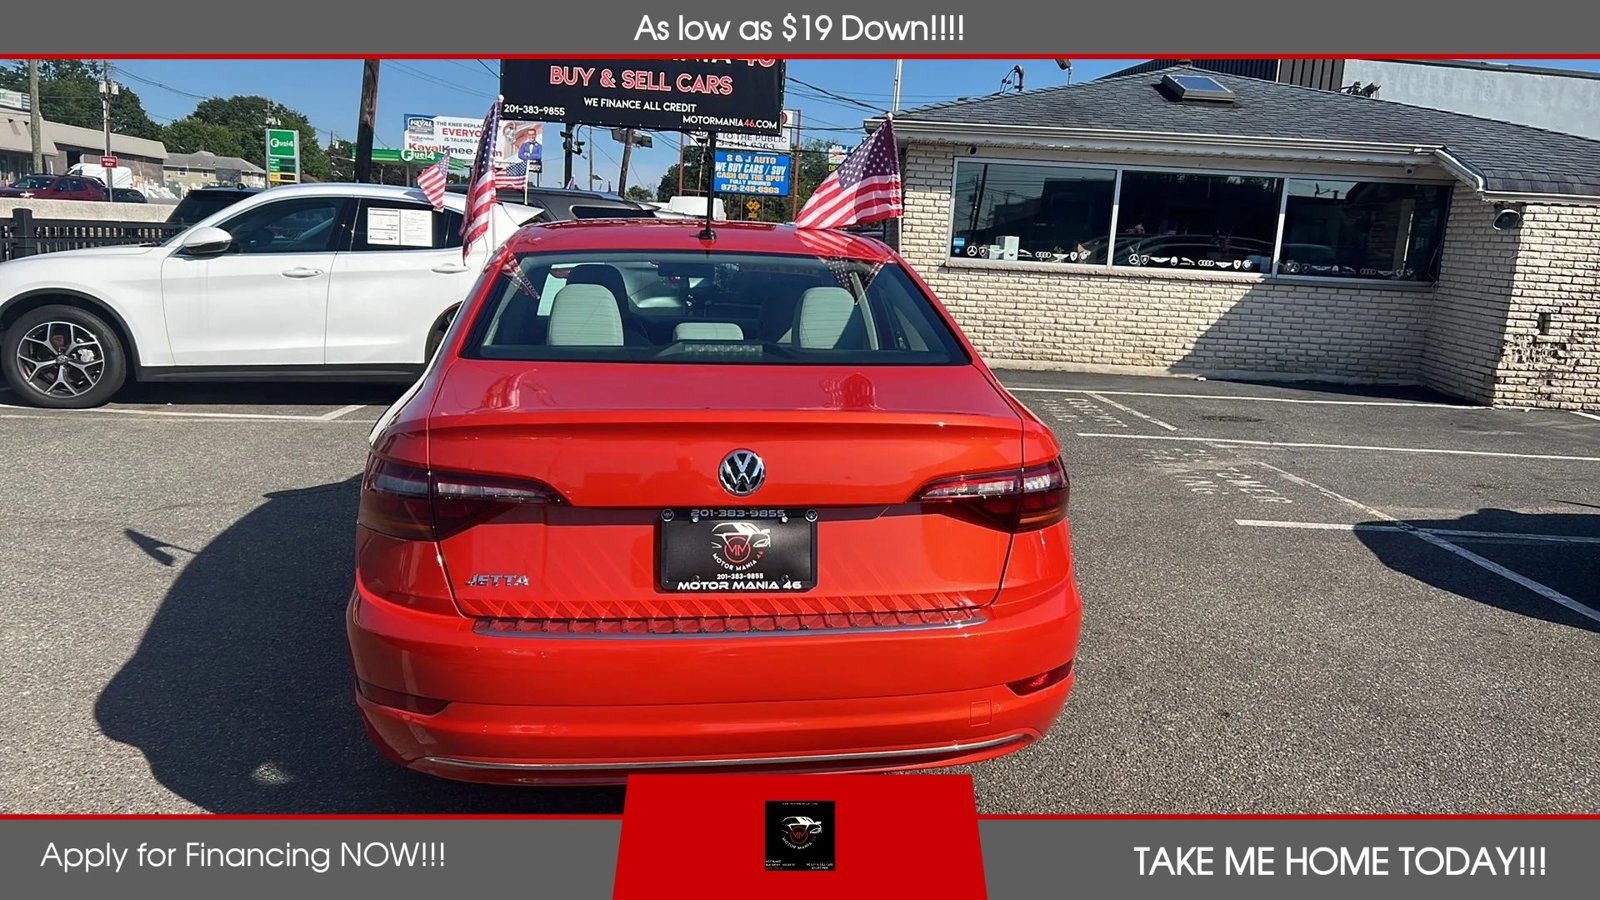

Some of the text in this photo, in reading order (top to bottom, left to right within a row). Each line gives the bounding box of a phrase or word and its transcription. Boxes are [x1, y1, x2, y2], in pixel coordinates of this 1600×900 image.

[549, 65, 734, 96] BUY & SELL CARS
[503, 104, 566, 116] 201-383-9855
[583, 97, 698, 113] WE FINANCE ALL CREDIT
[682, 115, 778, 129] MOTORMANIA46.COM
[442, 127, 482, 138] EVERYO
[755, 135, 787, 143] PUBLIC
[753, 156, 777, 164] AUTO
[715, 161, 727, 172] WE
[728, 162, 743, 172] BUY
[744, 163, 764, 174] CARS
[716, 171, 736, 179] CASH
[750, 173, 764, 181] THE
[765, 174, 785, 182] SPOT
[690, 508, 786, 518] 201-383-9855
[712, 552, 734, 570] MOTOR
[735, 559, 758, 571] MANIA
[465, 574, 529, 586] JETTA
[677, 580, 802, 590] MOTOR MANIA 46
